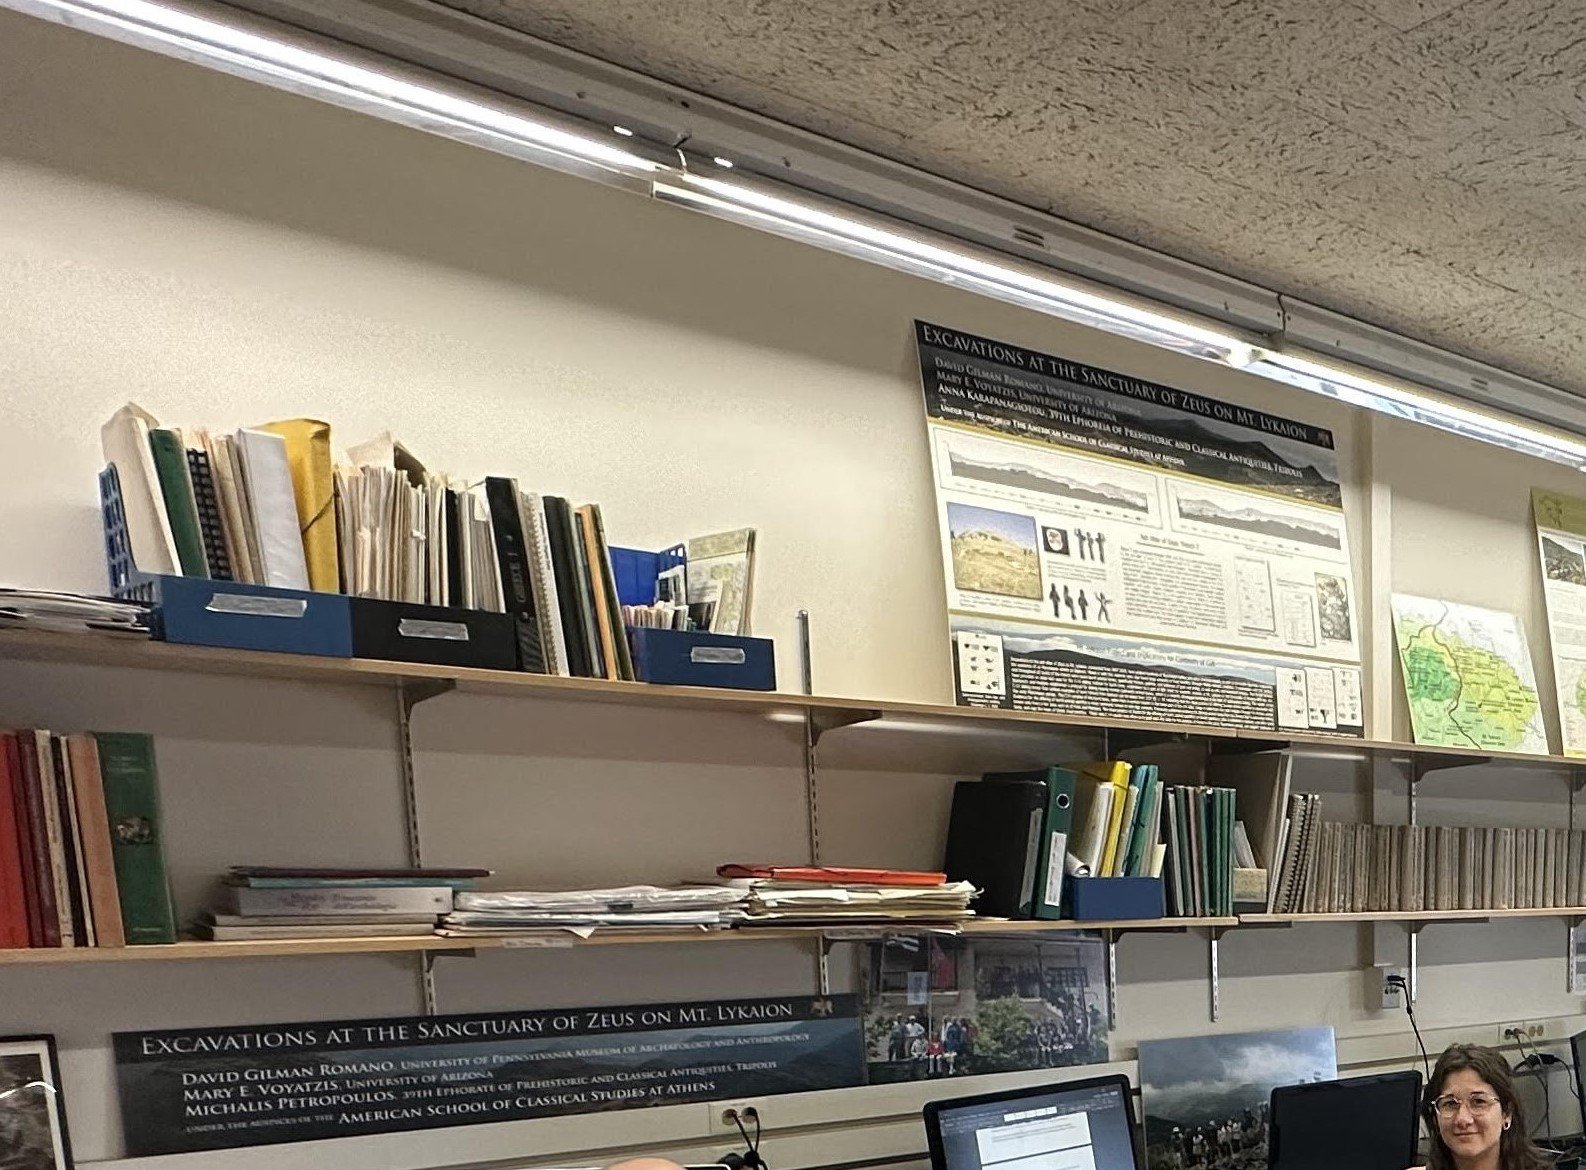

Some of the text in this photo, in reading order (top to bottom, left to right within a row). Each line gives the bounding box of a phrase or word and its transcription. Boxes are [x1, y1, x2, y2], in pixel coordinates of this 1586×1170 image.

[924, 325, 1024, 366] EXCAVATIONS
[1029, 356, 1044, 371] AT
[1048, 361, 1077, 380] THE
[1082, 367, 1157, 400] SANCTUARY
[1161, 390, 1177, 405] OF
[1180, 394, 1210, 414] ZEUS
[1214, 405, 1233, 420] ON
[1260, 415, 1307, 439] LYKAION
[938, 383, 966, 399] ANNA
[142, 1003, 793, 1055] EXCAVATIONS AT THE SANCTUARY OF ZEUS ON MT. LYKAION
[182, 1071, 240, 1086] DAVID
[244, 1067, 315, 1082] GILMAN
[400, 1056, 471, 1071] UNIVERSITY
[473, 1055, 488, 1065] OF
[492, 1050, 575, 1064] PENNSYLVANIA
[575, 1047, 621, 1058] MUSEUM
[714, 1037, 735, 1048] AND
[736, 1032, 810, 1046] ANTHROPOLOGY
[184, 1087, 233, 1101] MARY
[346, 1076, 419, 1090] UNIVERSITY
[421, 1074, 438, 1084] OF
[441, 1071, 494, 1082] ARIZONA
[185, 1100, 273, 1117] MICHALIS
[402, 1089, 433, 1100] 39TH
[436, 1084, 496, 1097] EPHORATE
[499, 1081, 513, 1091] OF
[516, 1077, 590, 1091] PREHISTORIC
[591, 1074, 615, 1084] AND
[616, 1070, 668, 1082] CLASSICAL
[736, 1060, 778, 1071] TRIPOLIS
[338, 1107, 422, 1125] AMERICAN
[427, 1101, 490, 1116] SCHOOL
[492, 1099, 511, 1111] OF
[516, 1093, 589, 1109] CLASSICAL
[591, 1087, 645, 1101] STUDIES
[649, 1084, 665, 1096] AT
[666, 1081, 716, 1095] ATHENS
